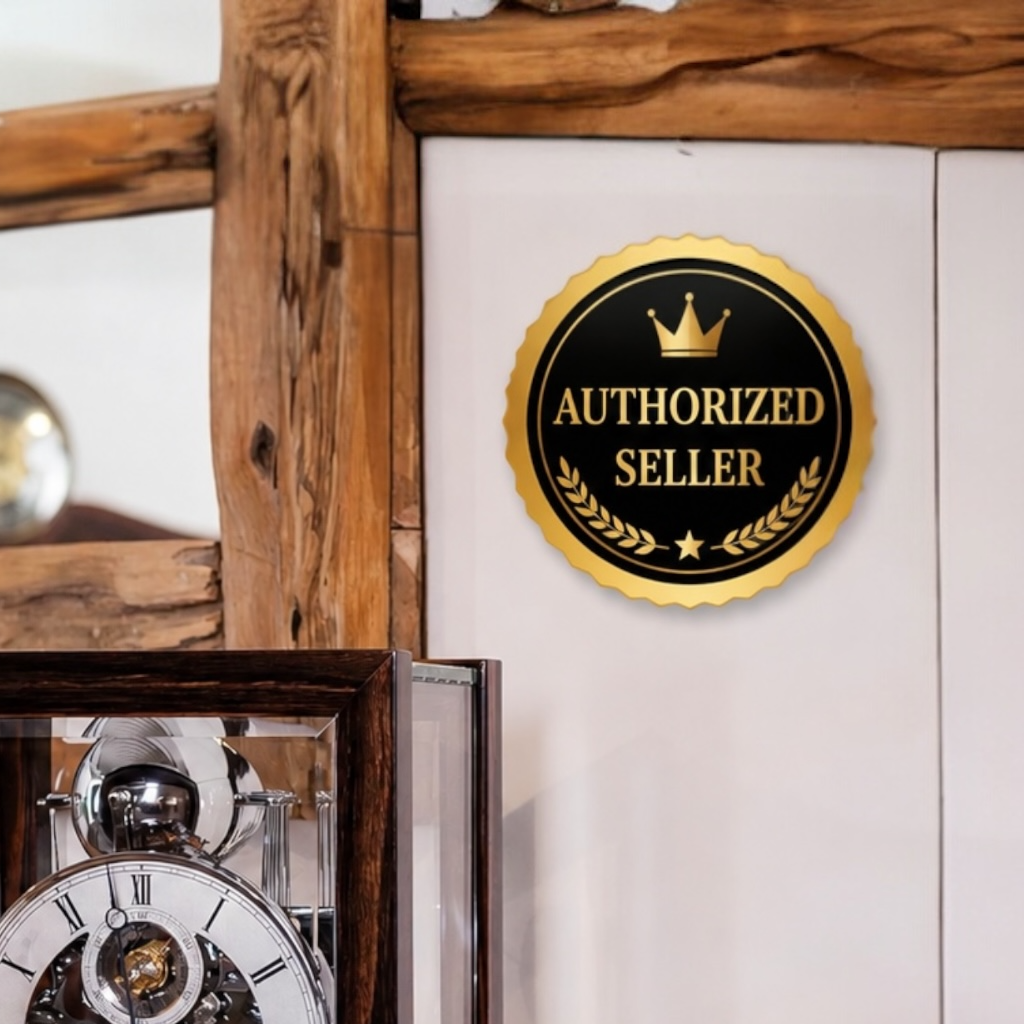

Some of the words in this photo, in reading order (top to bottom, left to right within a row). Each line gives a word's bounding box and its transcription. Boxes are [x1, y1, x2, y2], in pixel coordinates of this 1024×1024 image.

[131, 874, 152, 906] XII
[51, 891, 87, 936] XI
[202, 895, 229, 933] I
[0, 952, 37, 983] X
[248, 955, 288, 987] II
